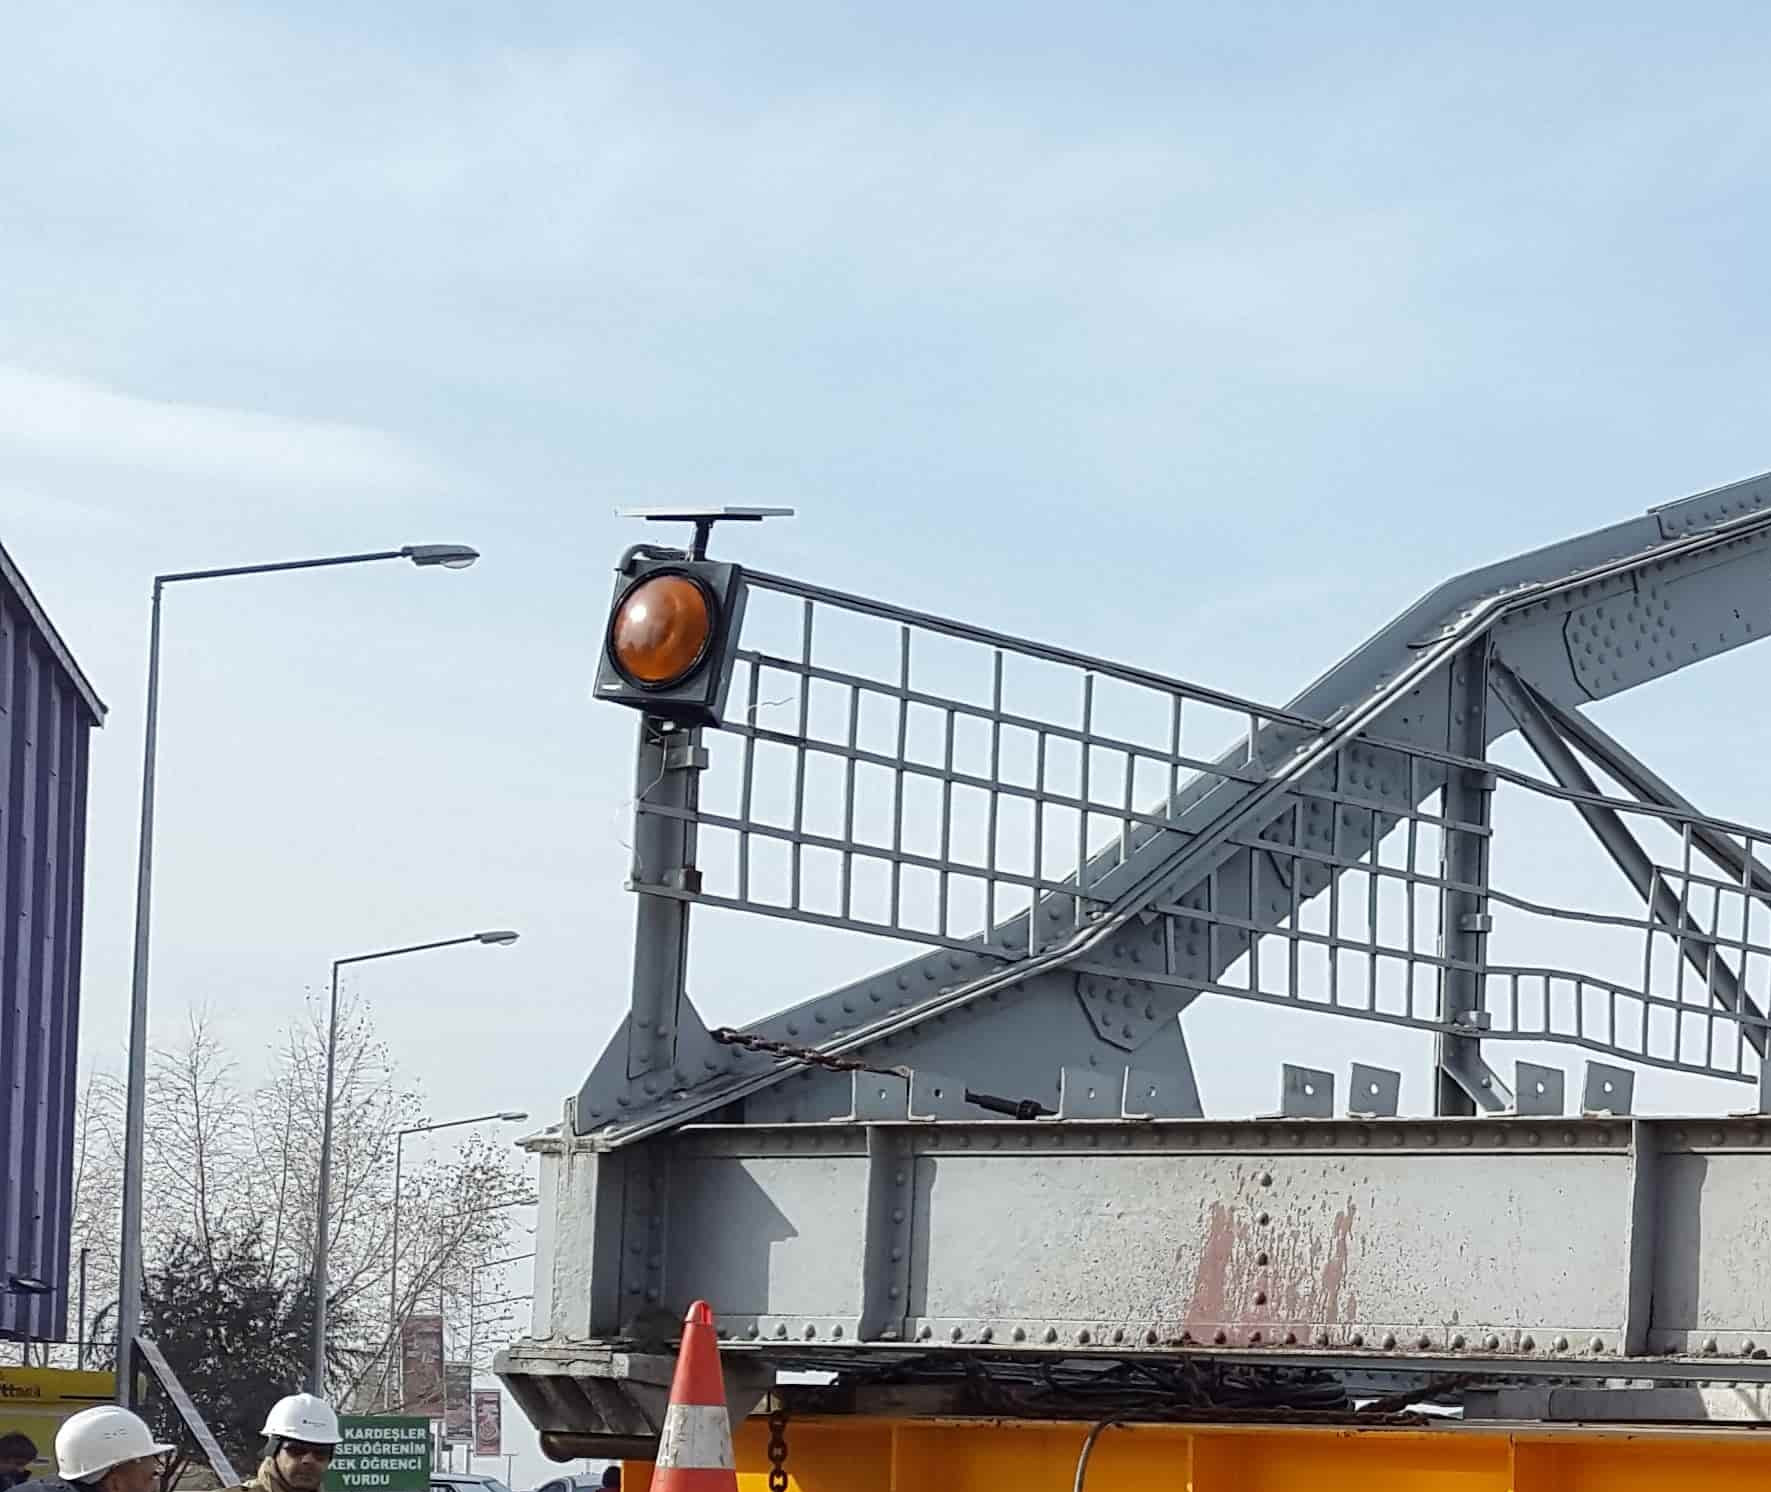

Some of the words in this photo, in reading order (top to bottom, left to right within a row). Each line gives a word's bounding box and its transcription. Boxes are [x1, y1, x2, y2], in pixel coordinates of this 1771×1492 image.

[344, 1427, 427, 1441] KARDEŞLER
[335, 1441, 426, 1455] SEKÖĞRENİM
[328, 1459, 356, 1470] KEK
[361, 1455, 422, 1470] ÖĞRENCİ
[342, 1474, 390, 1486] YURDU
